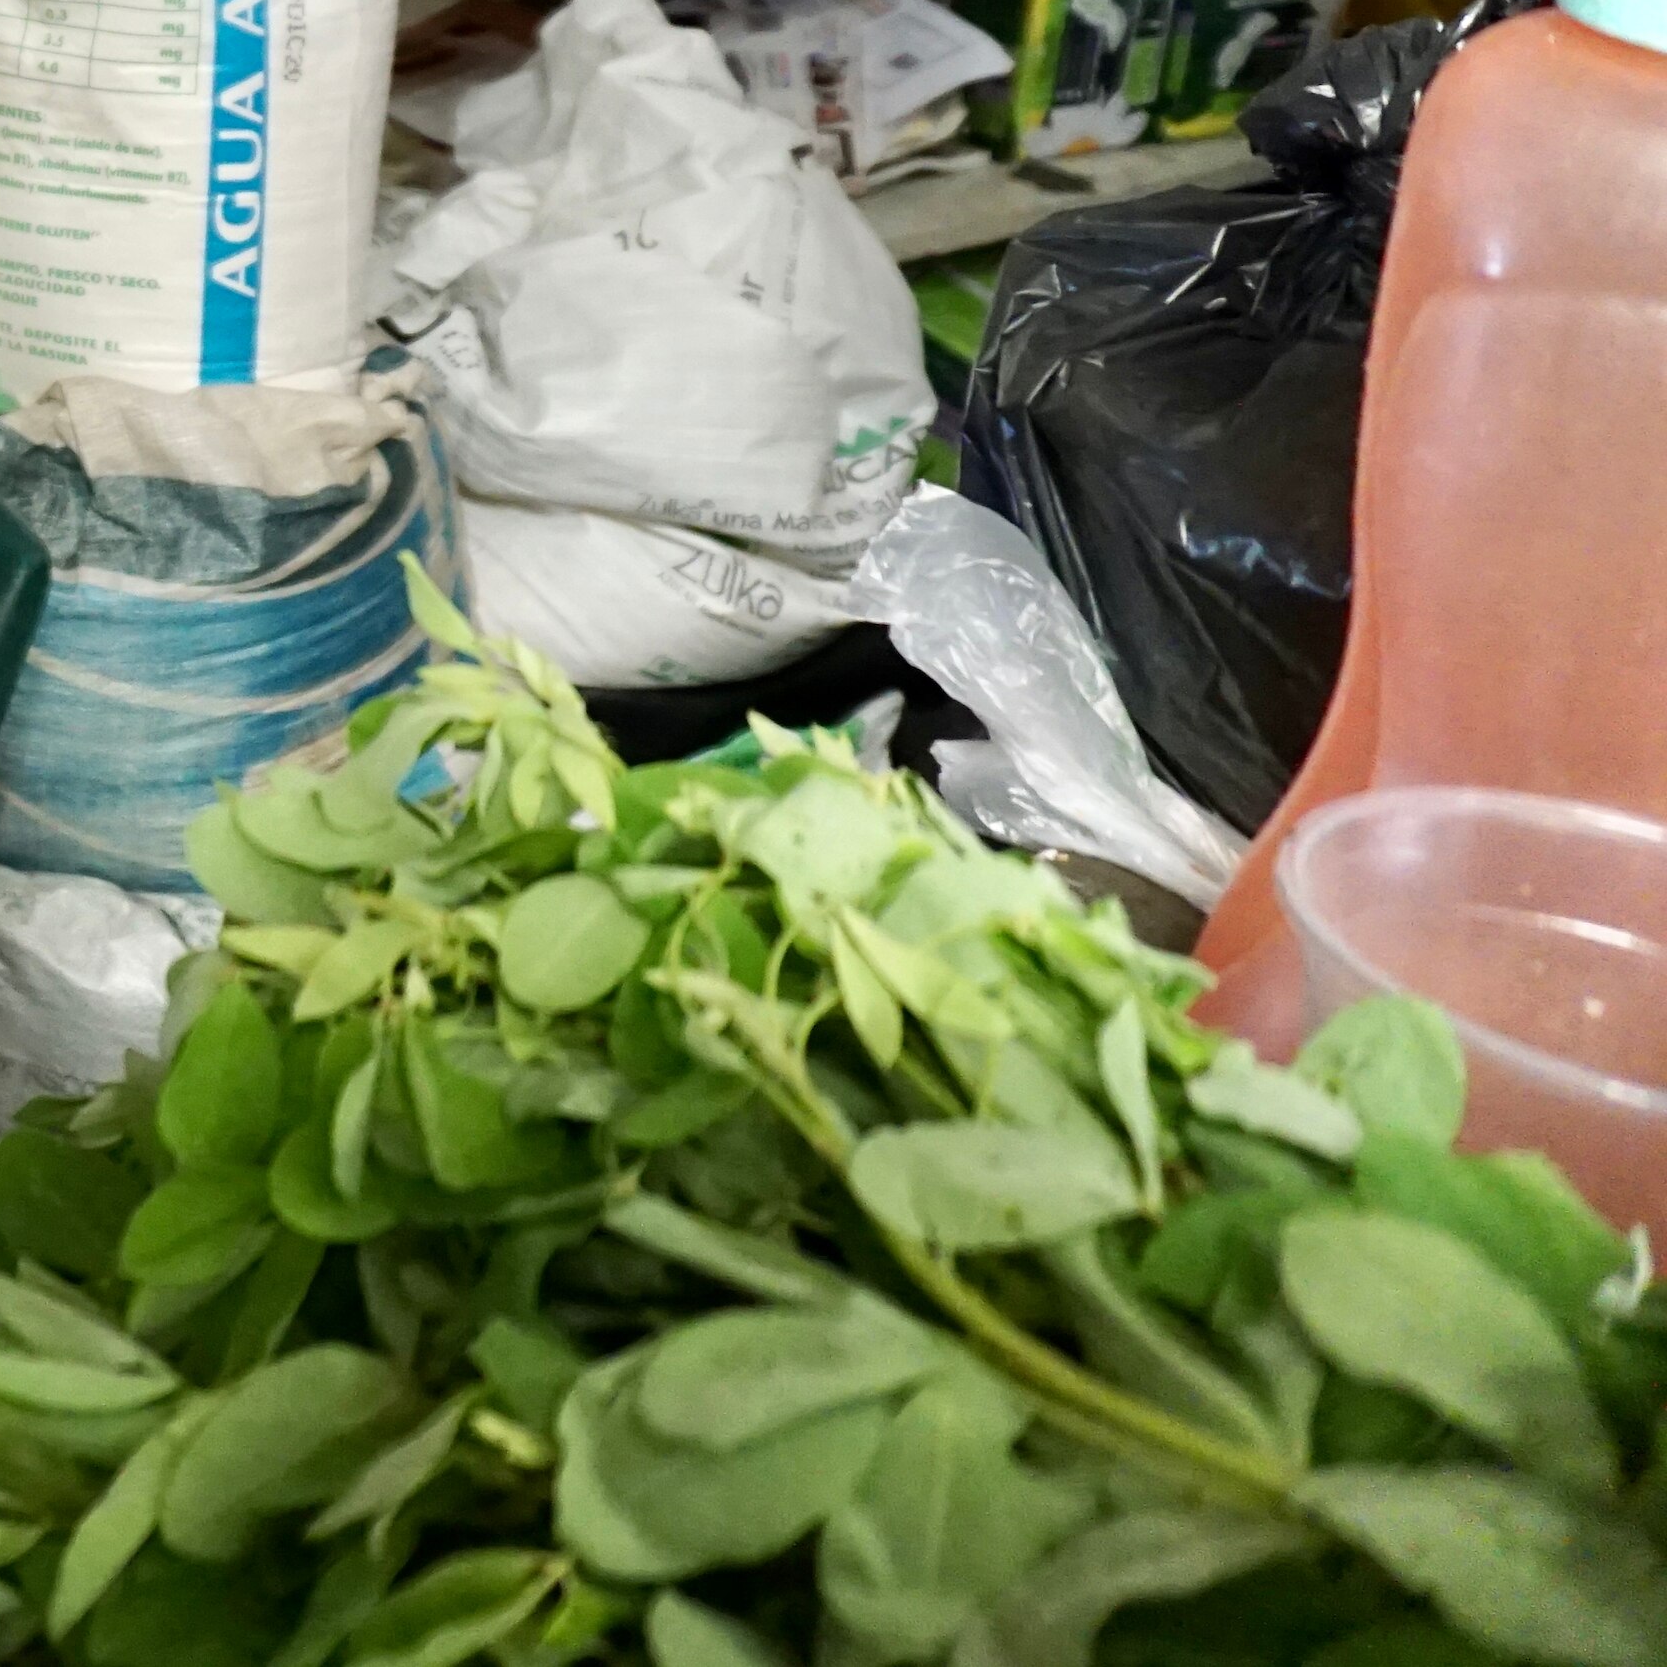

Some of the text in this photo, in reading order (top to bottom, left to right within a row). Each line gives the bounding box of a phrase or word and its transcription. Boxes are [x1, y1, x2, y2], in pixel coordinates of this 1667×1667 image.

[210, 70, 267, 299] AGUA
[47, 265, 103, 286] FRESCO
[671, 549, 785, 621] Zulka
